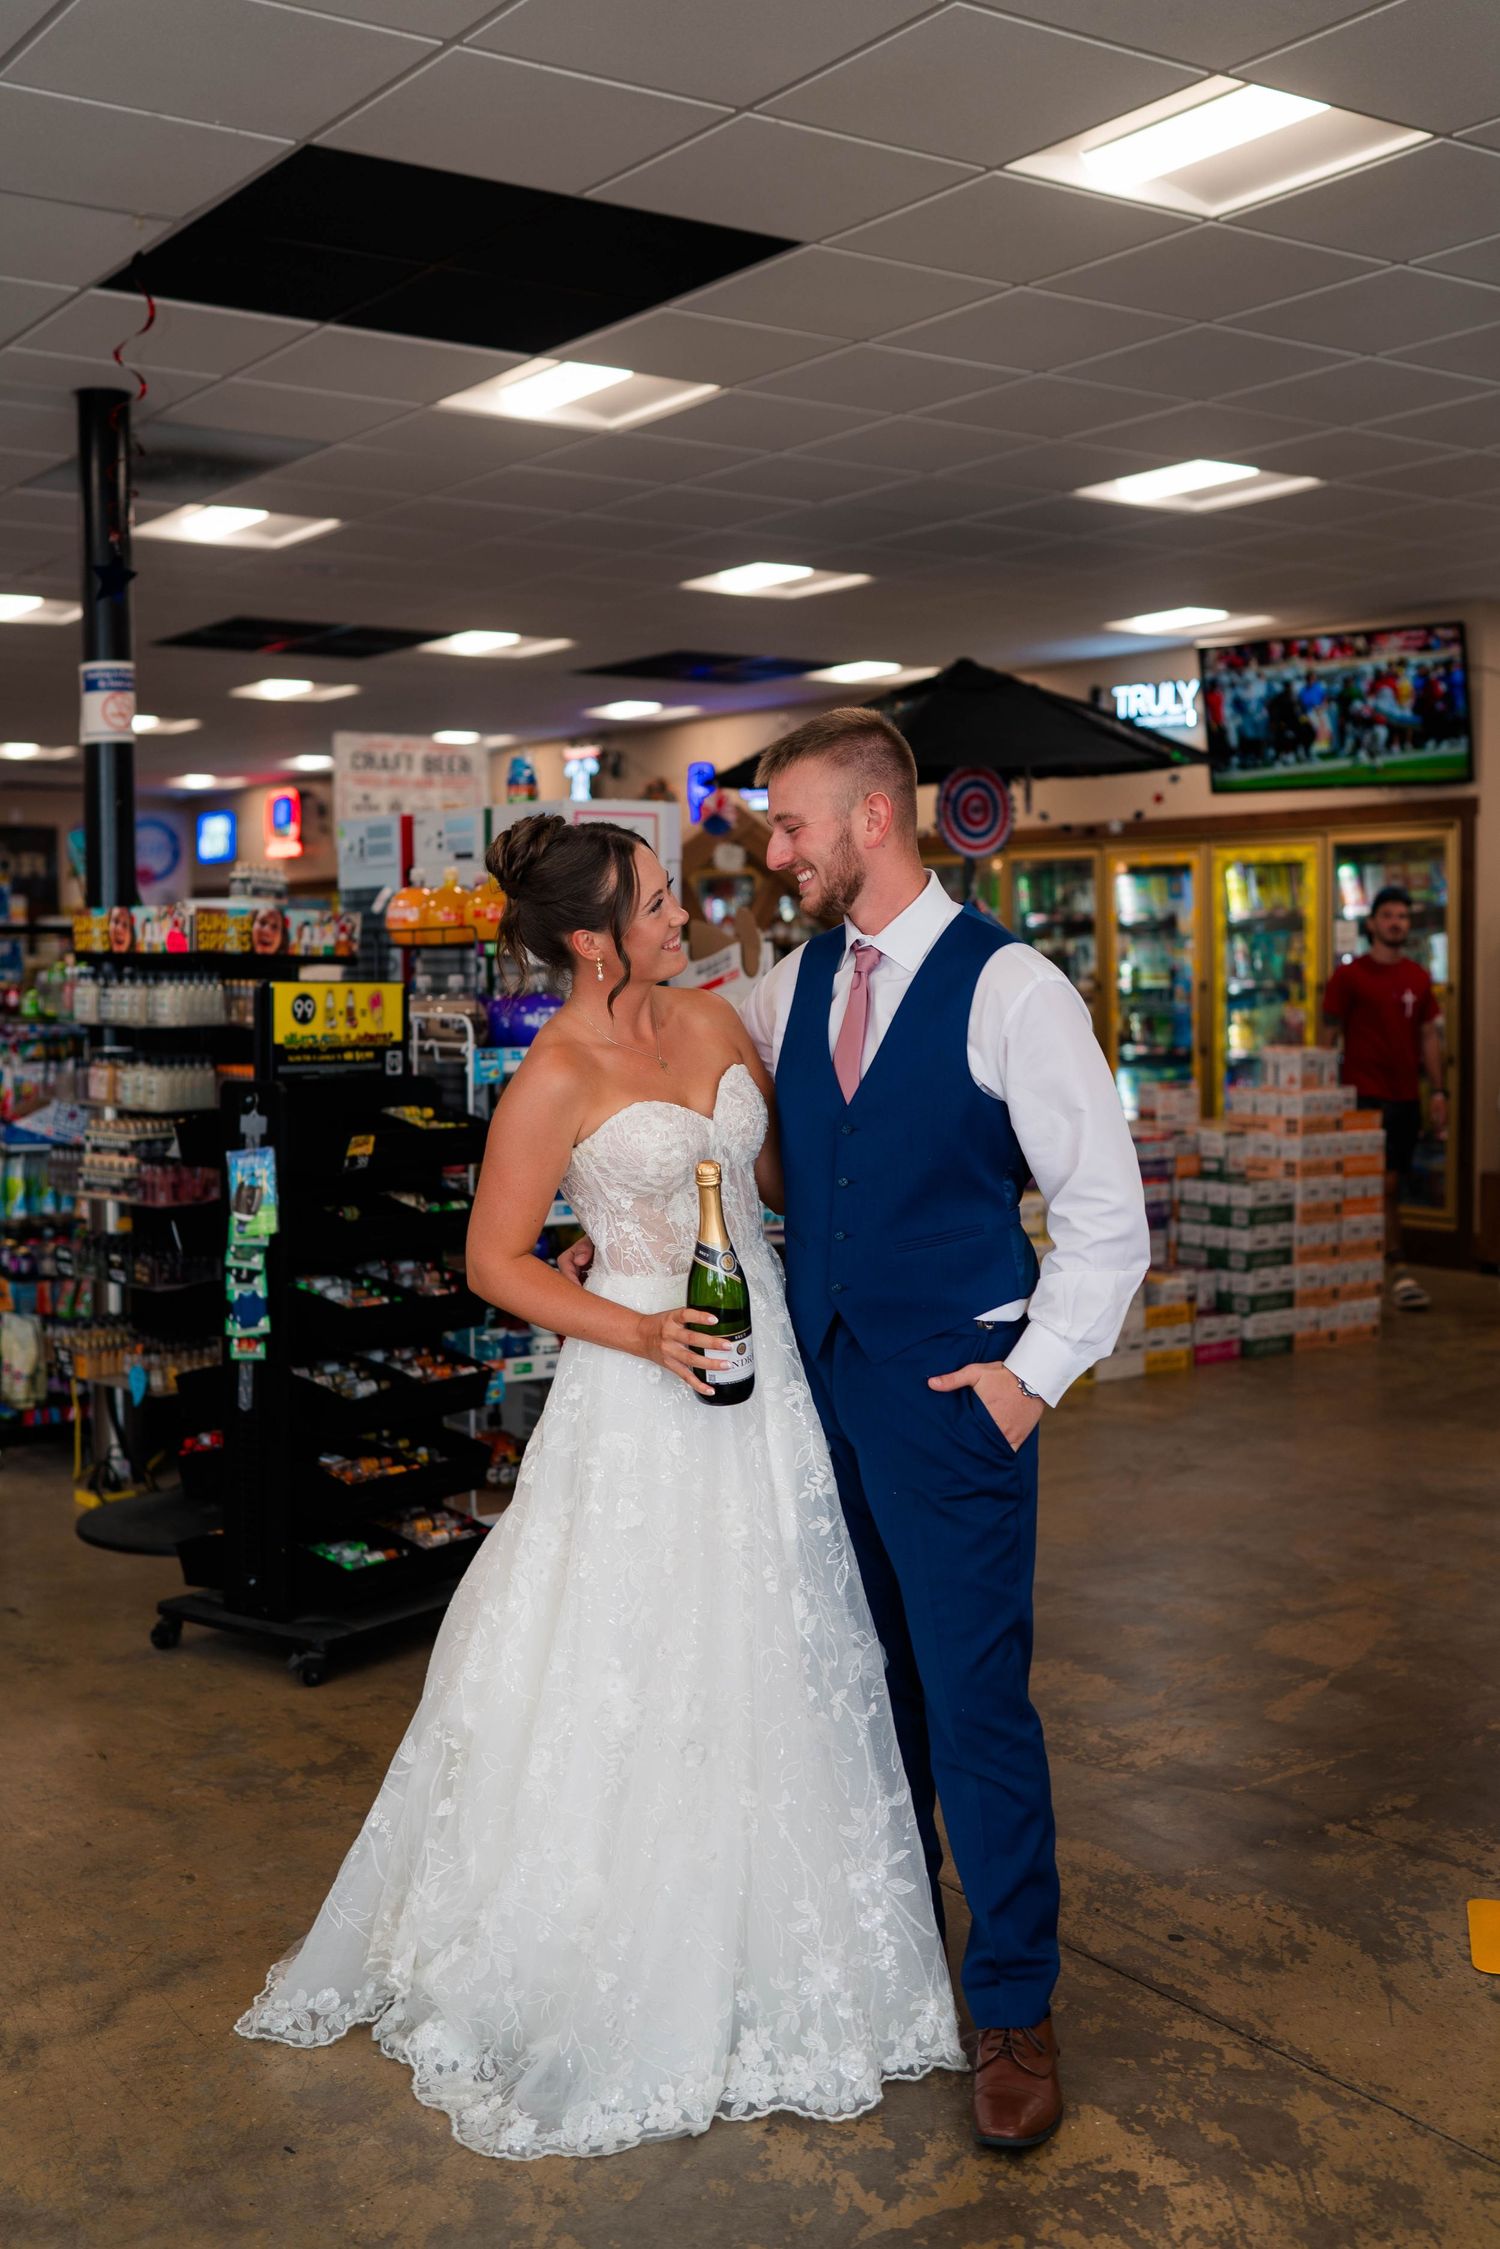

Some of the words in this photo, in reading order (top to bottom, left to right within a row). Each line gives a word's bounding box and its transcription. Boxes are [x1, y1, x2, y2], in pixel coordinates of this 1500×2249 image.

[1111, 678, 1200, 721] TRULY
[350, 751, 413, 772] CRAFT
[422, 753, 473, 775] BEER
[293, 998, 315, 1020] 99
[732, 1353, 754, 1370] NDR
